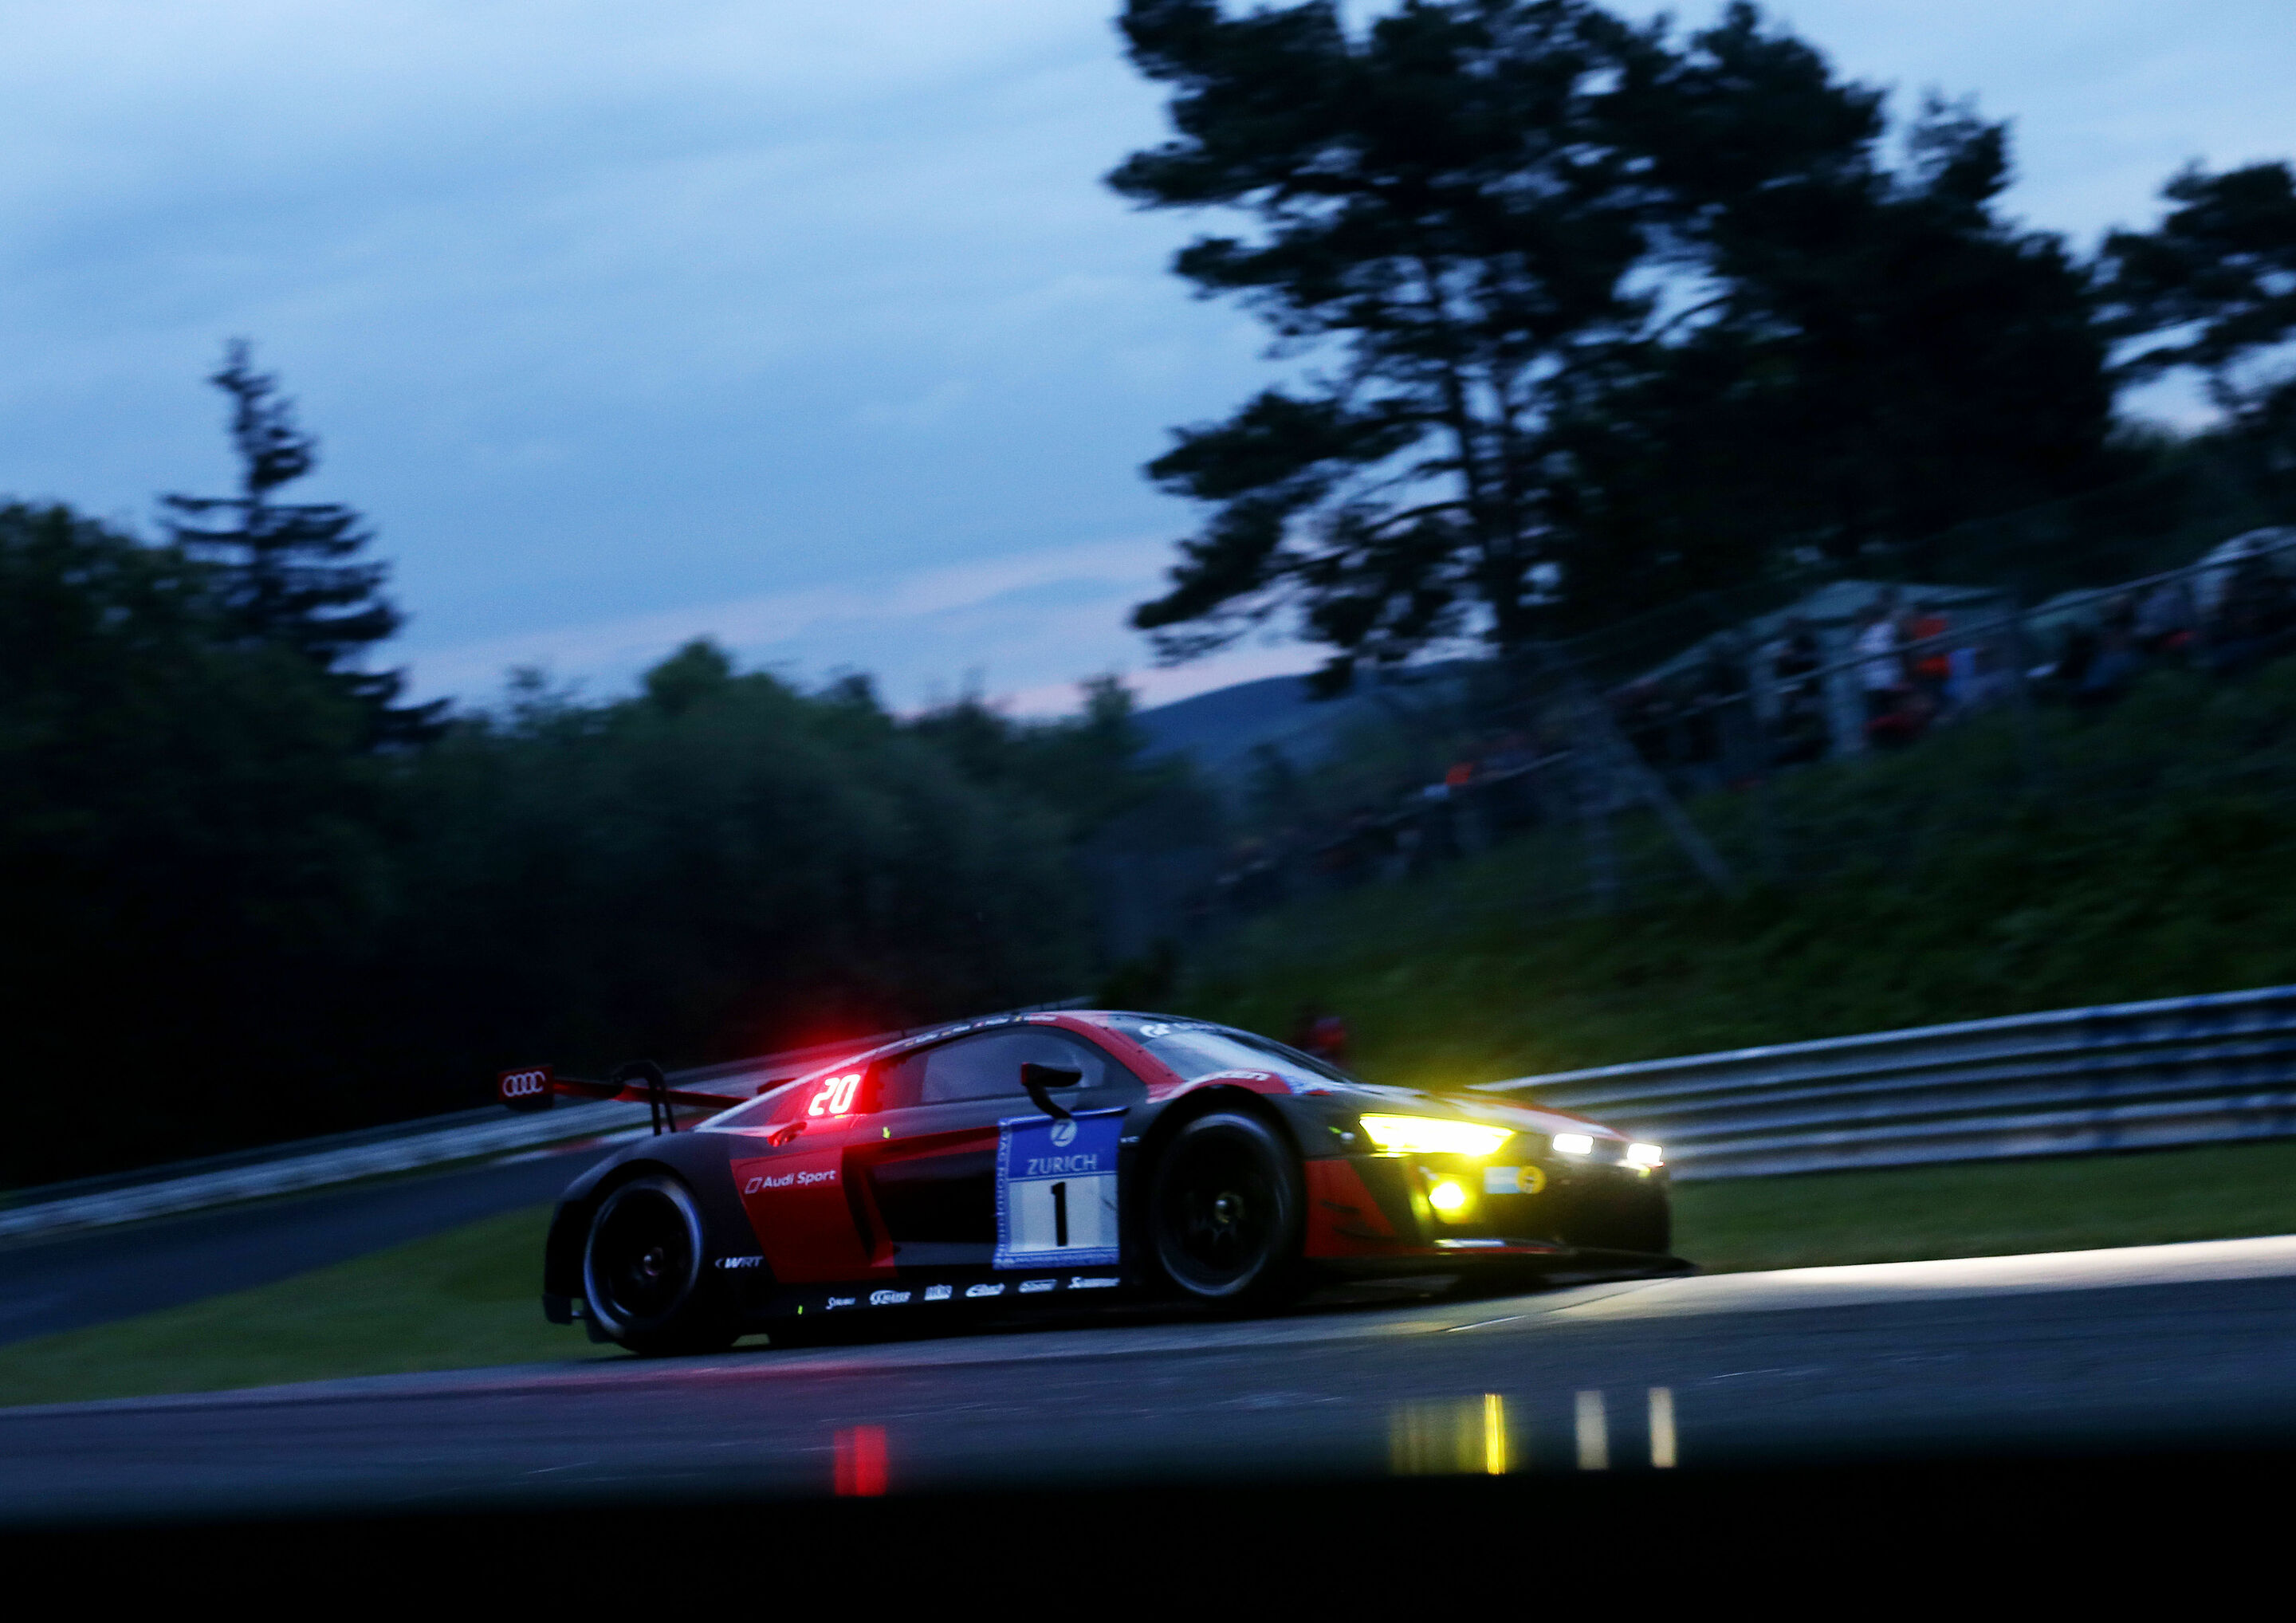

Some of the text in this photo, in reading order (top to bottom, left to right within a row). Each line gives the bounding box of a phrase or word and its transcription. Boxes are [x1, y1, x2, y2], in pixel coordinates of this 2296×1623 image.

[808, 1074, 861, 1116] 20
[762, 1169, 836, 1189] Audi Sport
[1027, 1153, 1098, 1176] ZURICH
[1050, 1181, 1069, 1248] 1
